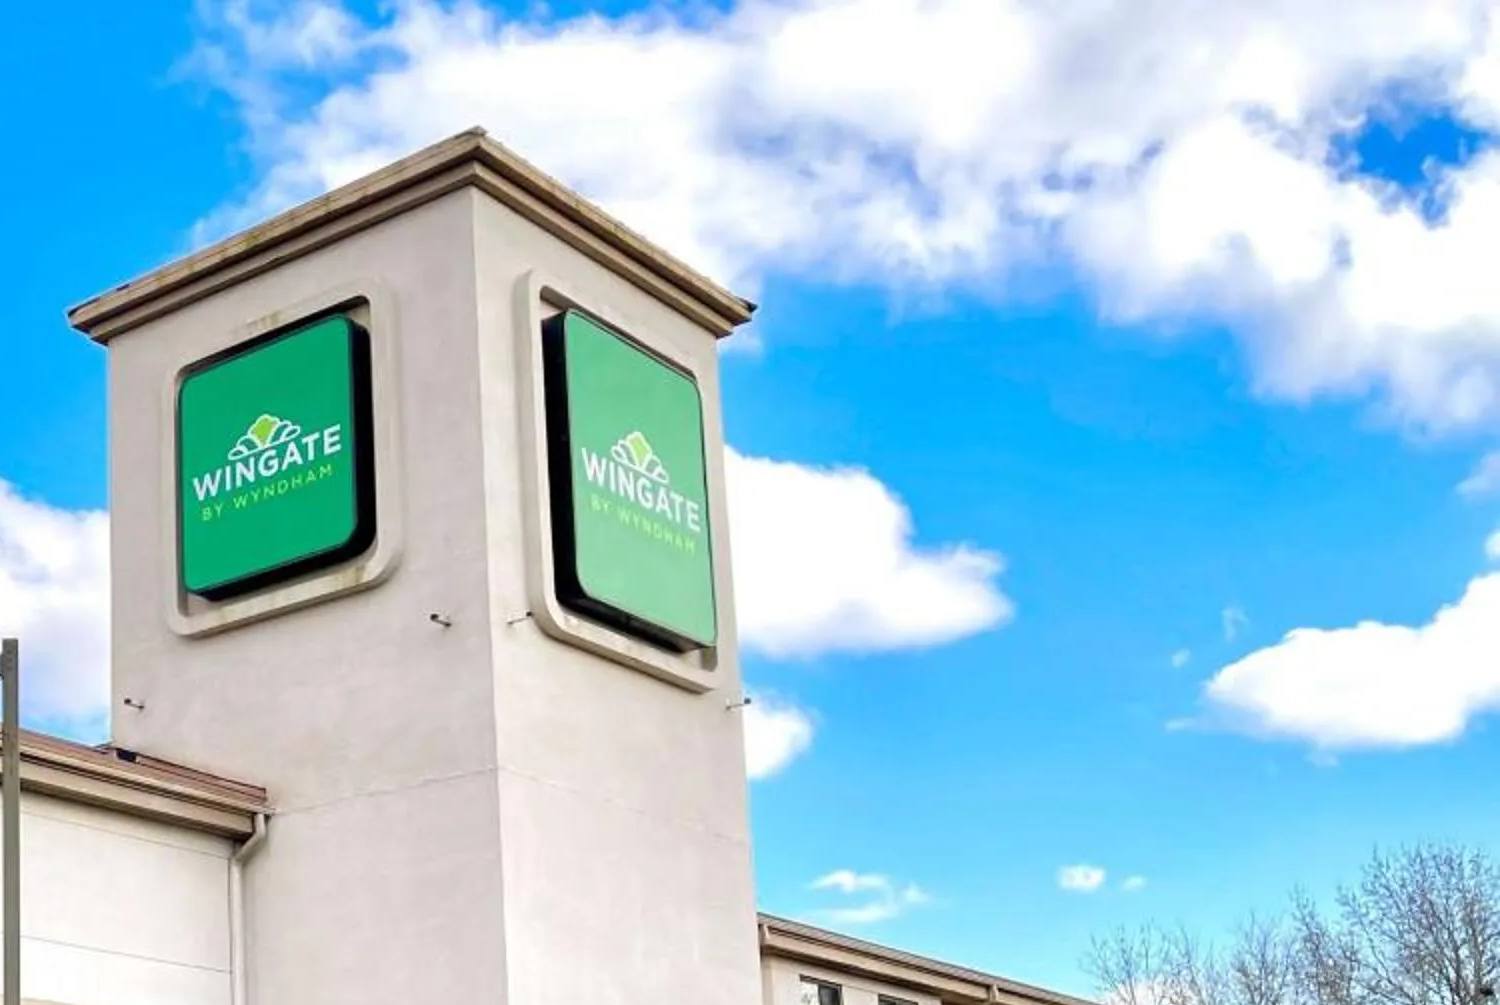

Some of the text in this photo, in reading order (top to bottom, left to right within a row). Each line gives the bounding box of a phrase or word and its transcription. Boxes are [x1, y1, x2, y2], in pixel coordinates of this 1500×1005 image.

[192, 424, 342, 501] WINGATE
[202, 464, 333, 521] BY WYNDHAM
[581, 447, 701, 533] WINGATE
[590, 493, 696, 556] BY WYNDHAM
